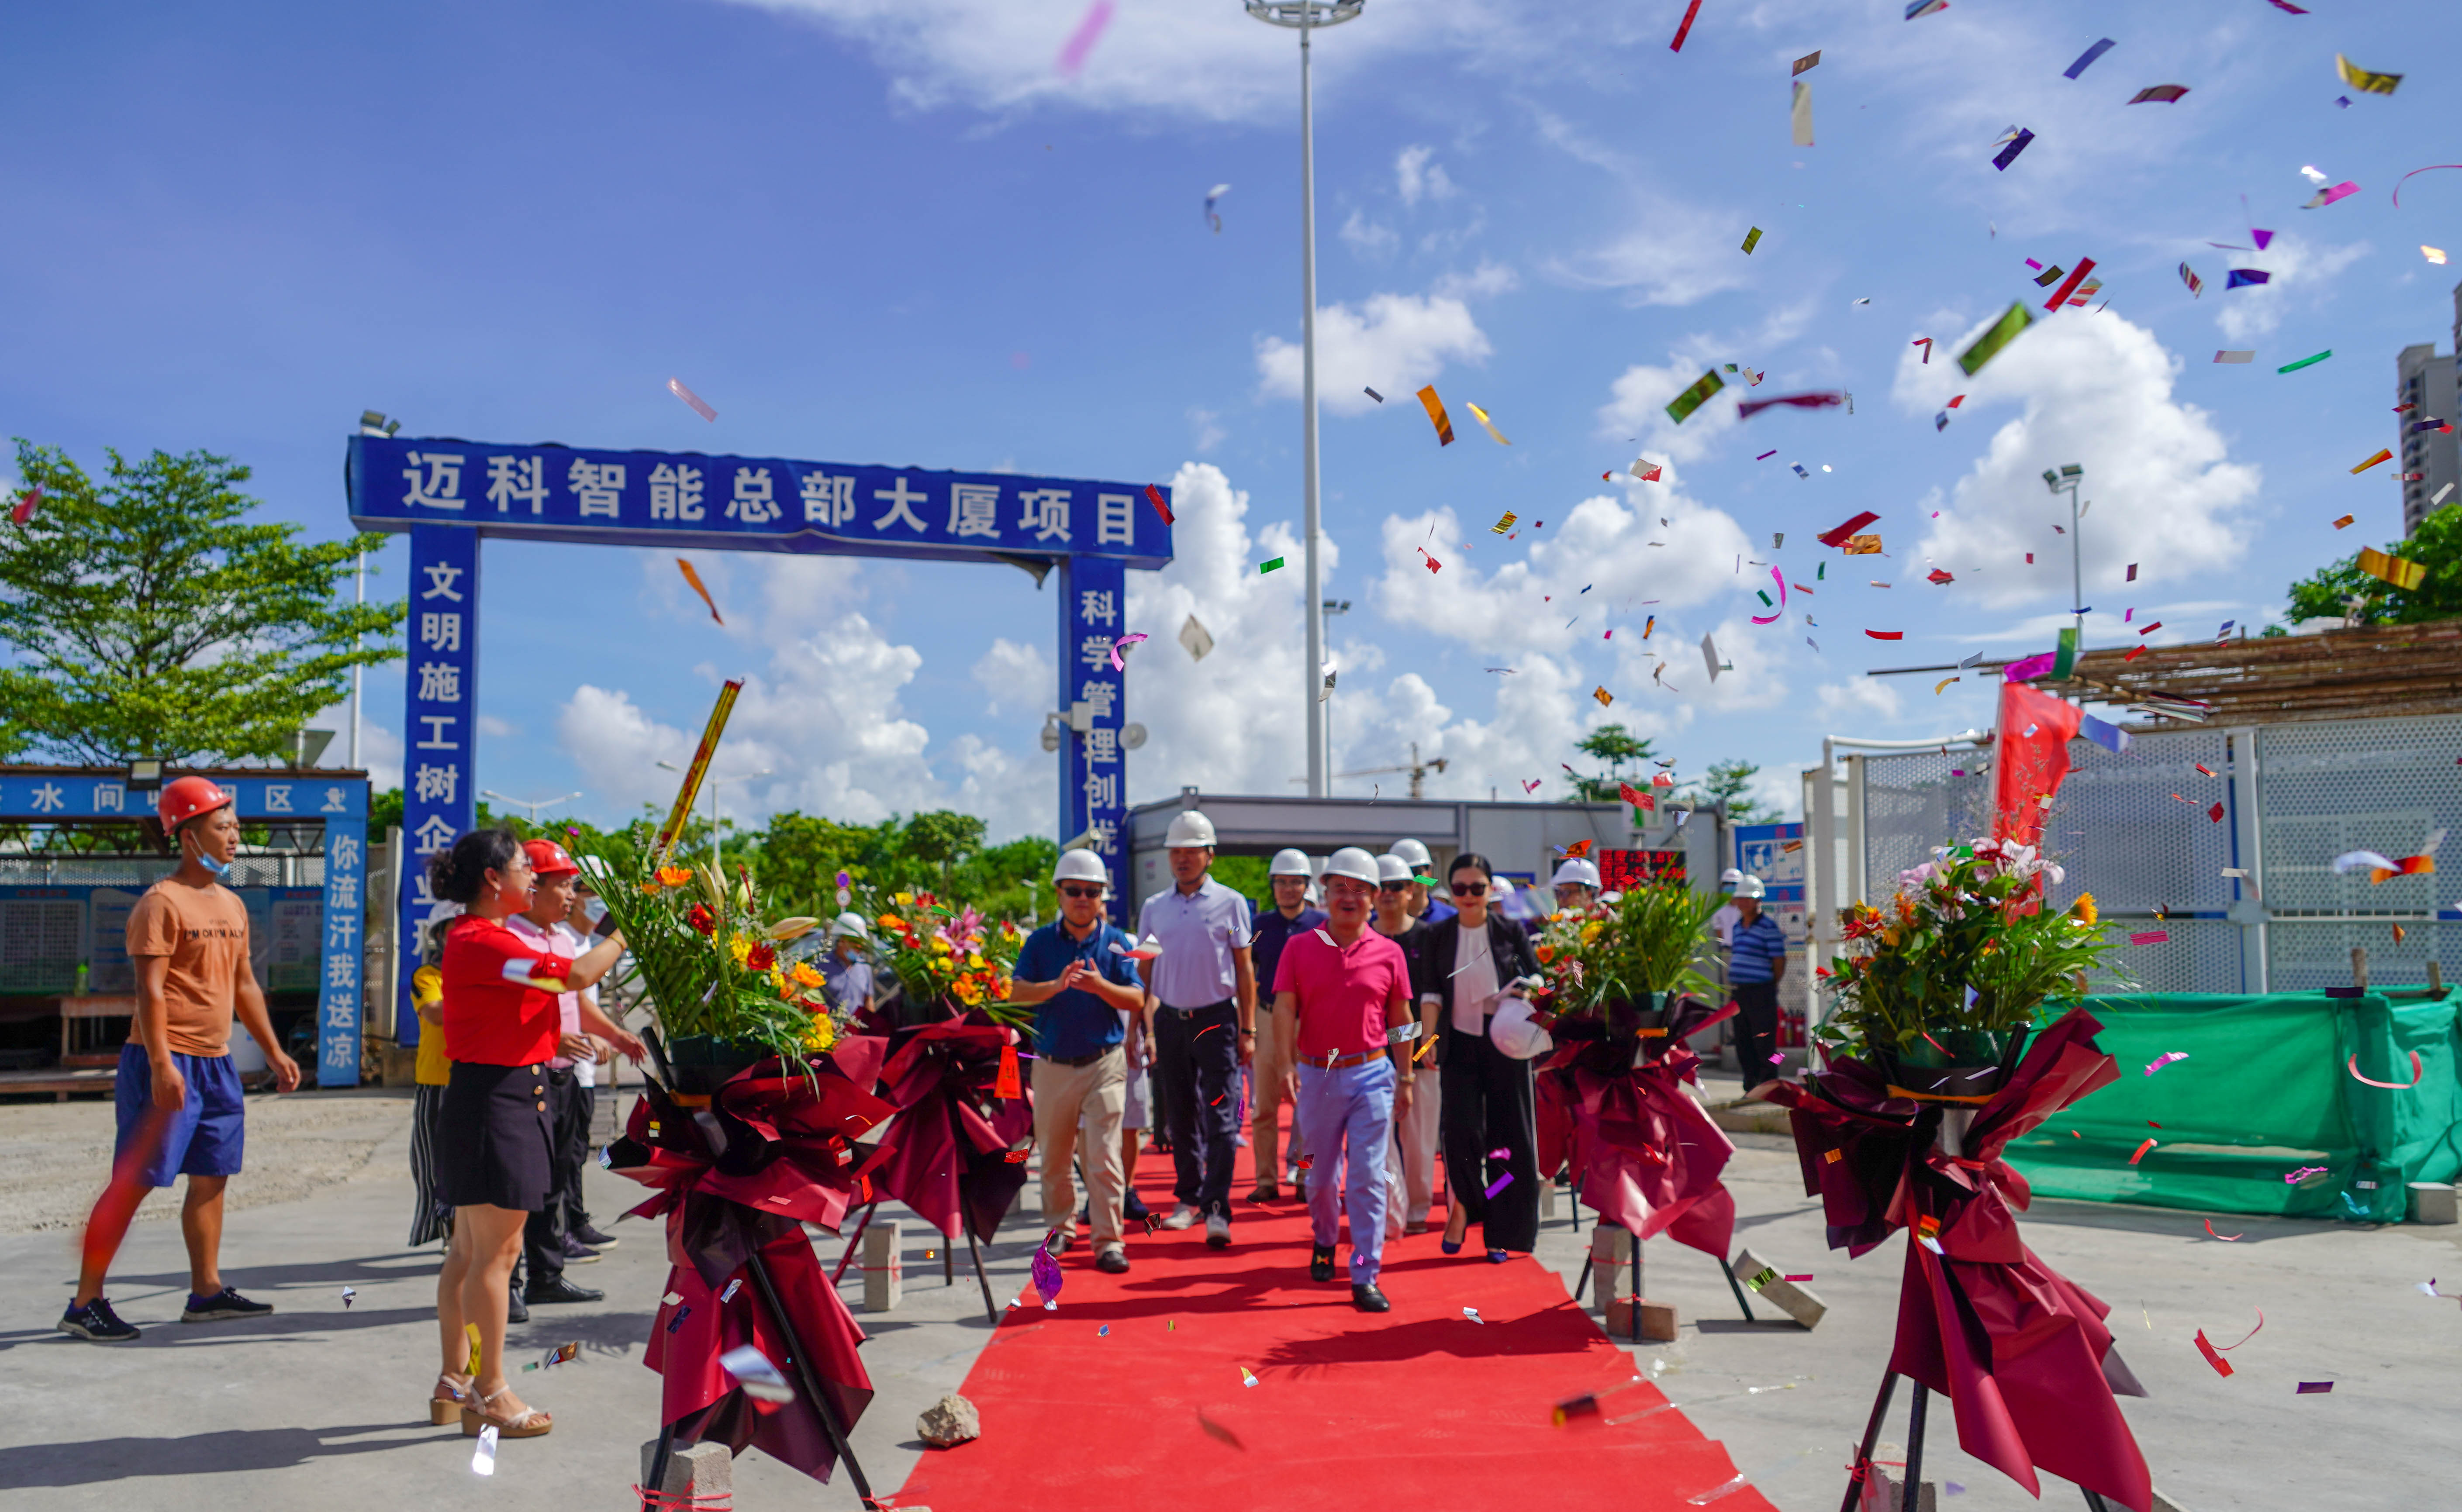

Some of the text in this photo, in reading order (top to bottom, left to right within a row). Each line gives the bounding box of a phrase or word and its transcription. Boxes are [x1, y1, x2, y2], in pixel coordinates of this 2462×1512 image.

[402, 450, 1136, 547] 迈科智能总部大厦项目
[1081, 590, 1119, 921] 科学管理创优
[325, 834, 359, 1068] 你流汗我送凉
